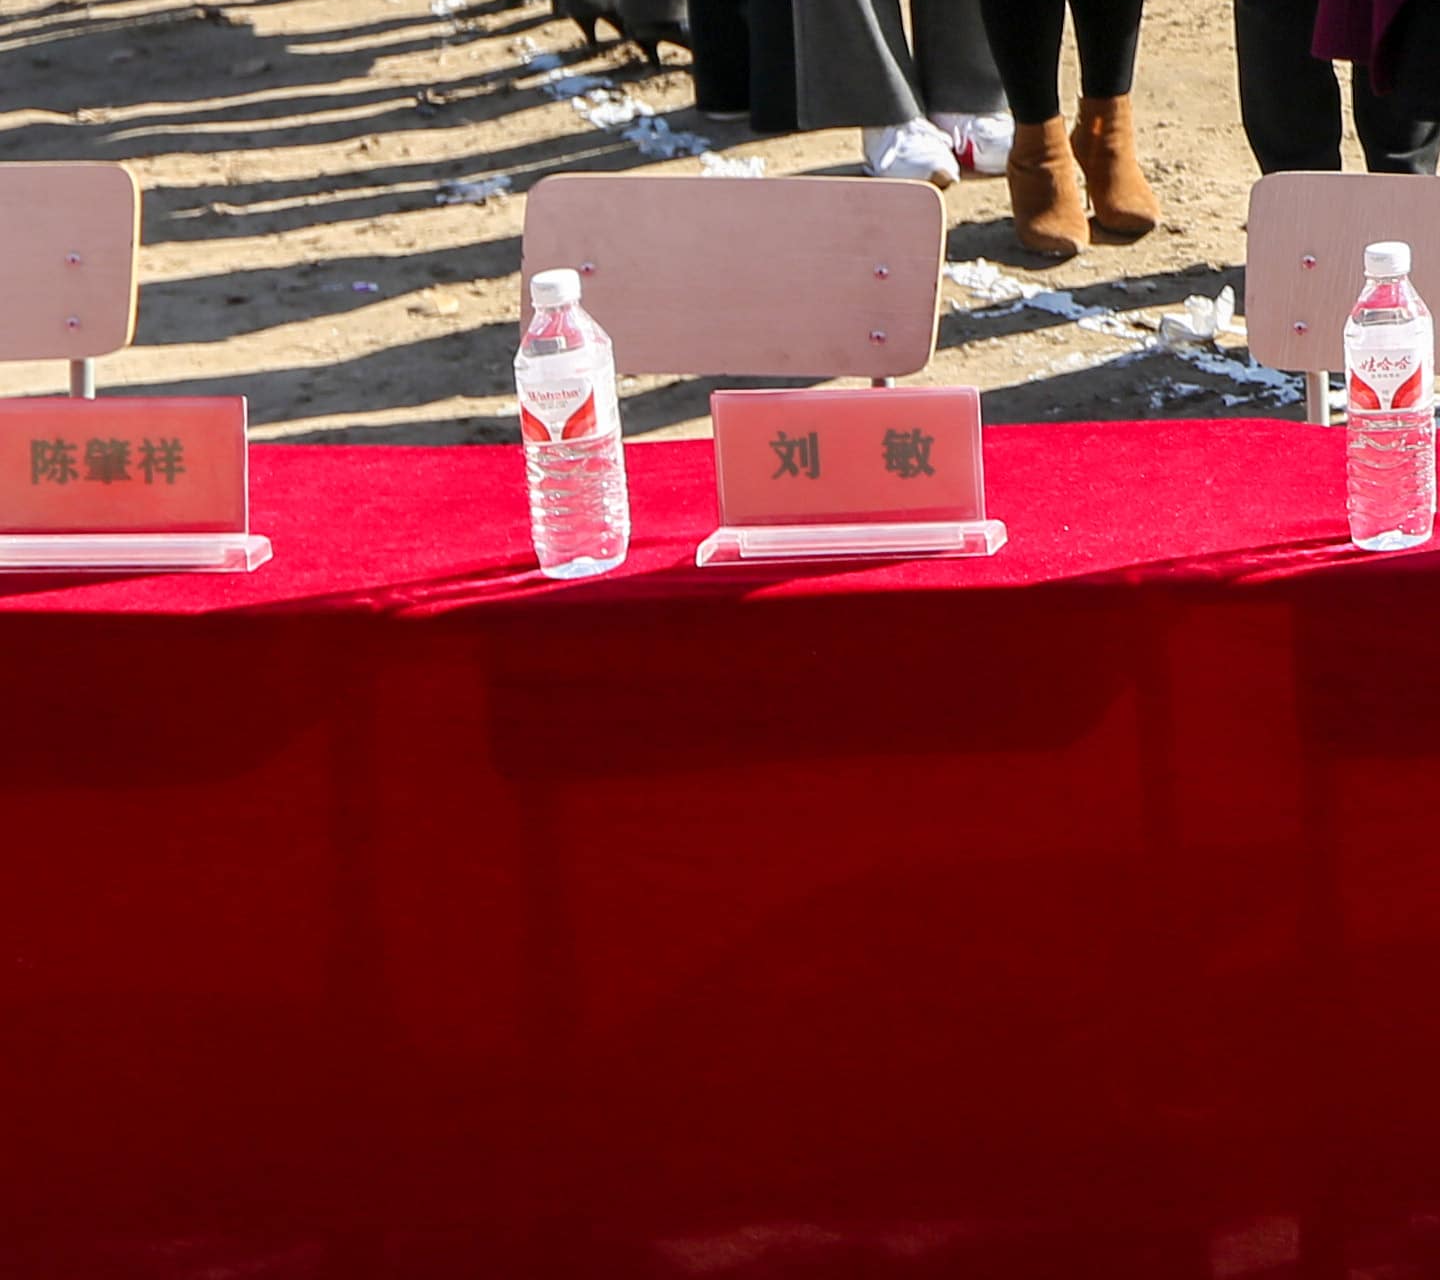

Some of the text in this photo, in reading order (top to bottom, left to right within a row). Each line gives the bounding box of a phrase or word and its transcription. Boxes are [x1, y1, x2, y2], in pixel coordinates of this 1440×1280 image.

[1360, 355, 1411, 372] 娃哈哈
[31, 437, 186, 485] 陈肇祥
